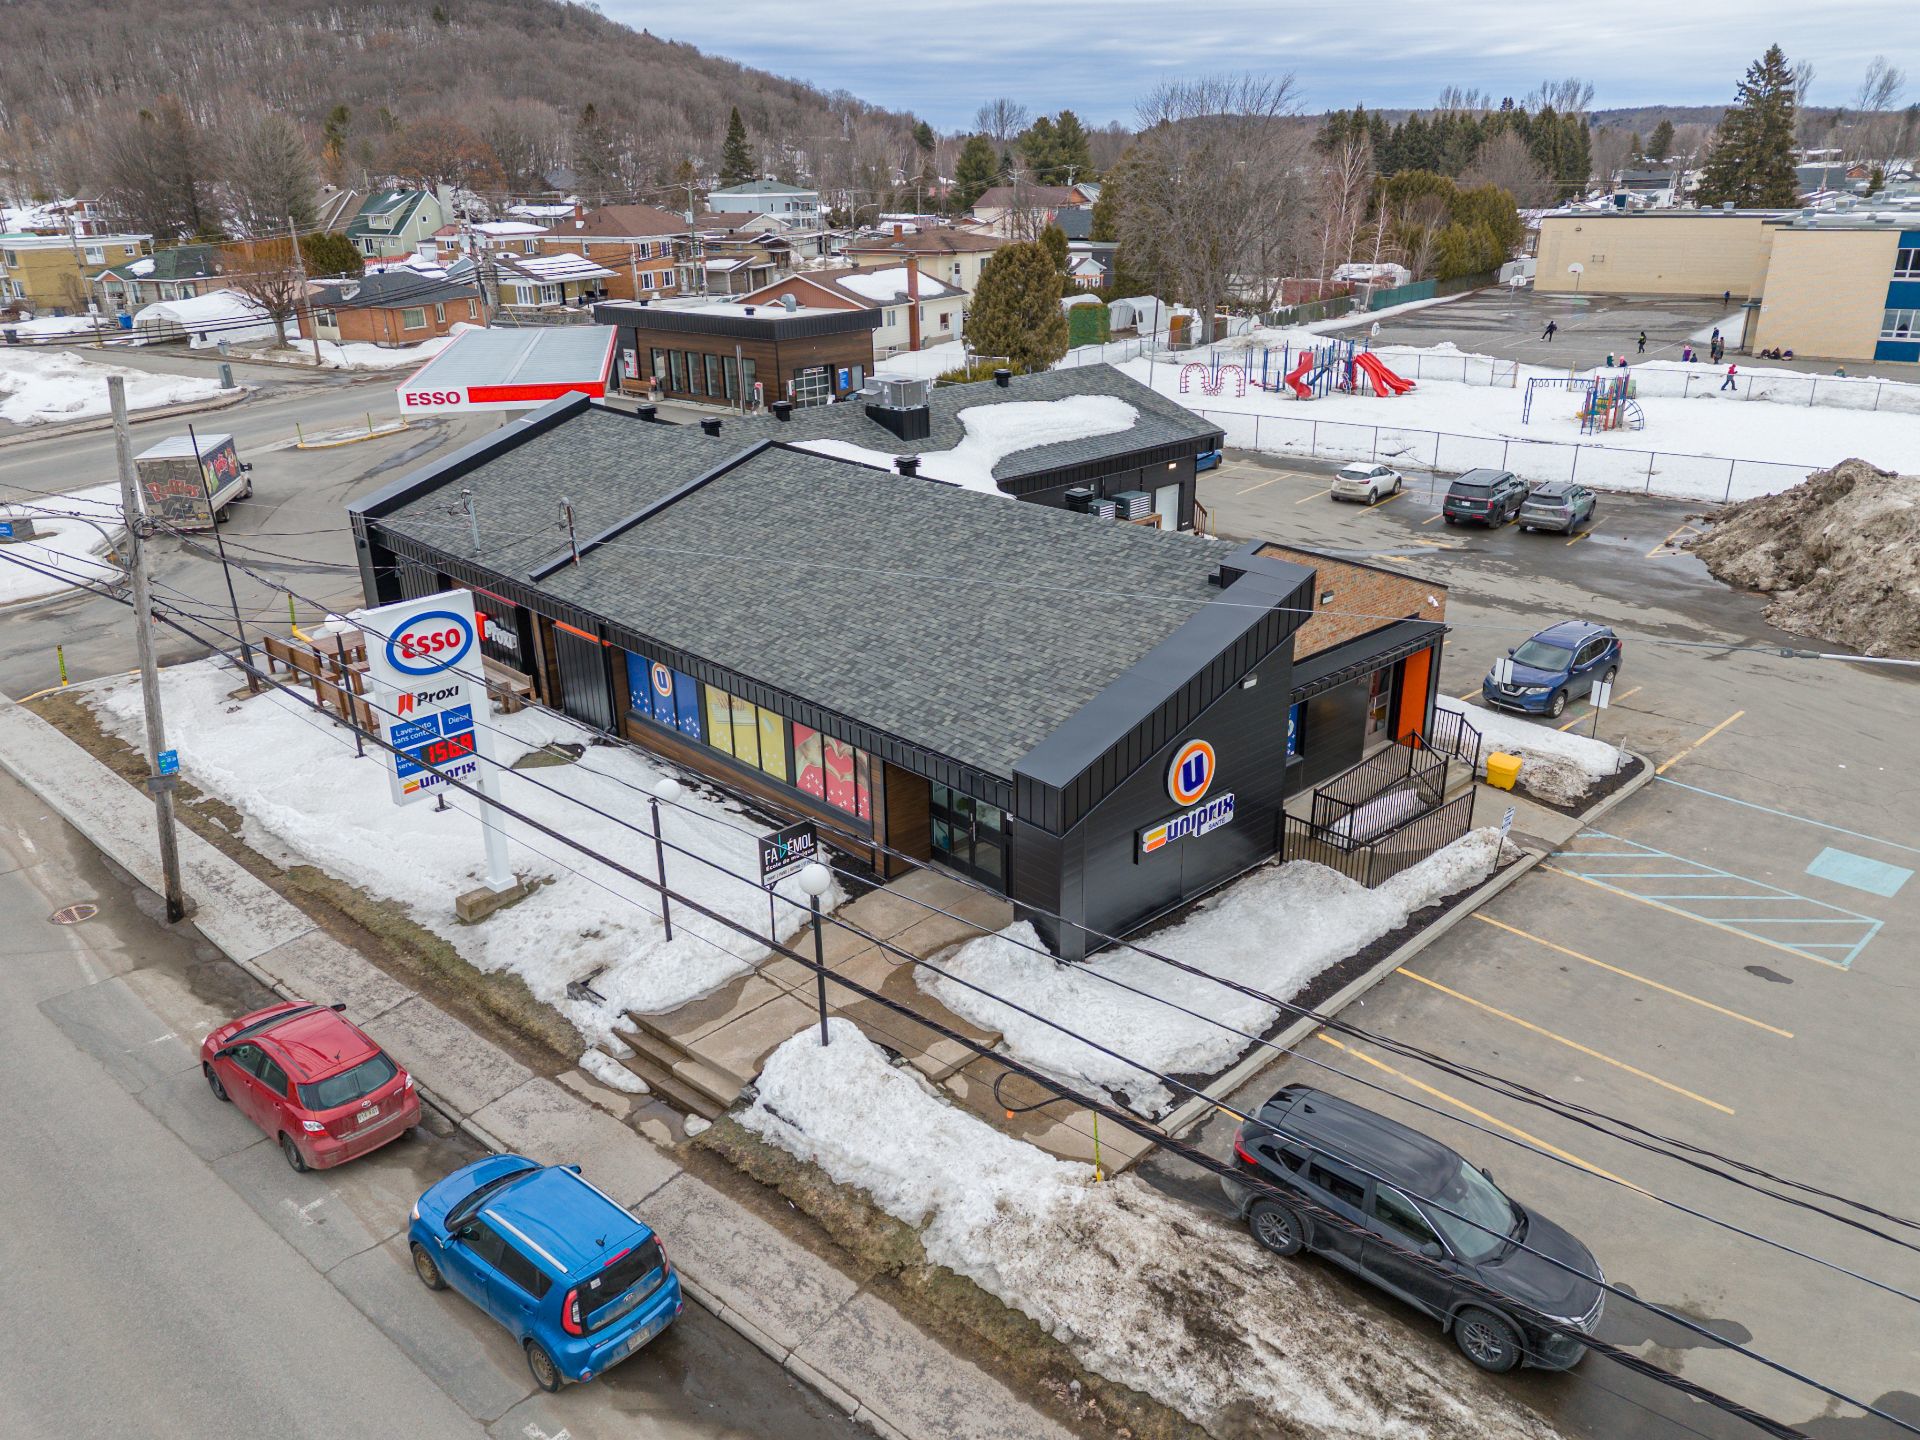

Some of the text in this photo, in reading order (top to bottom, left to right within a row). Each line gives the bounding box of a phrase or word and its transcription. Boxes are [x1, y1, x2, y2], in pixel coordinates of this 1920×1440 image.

[405, 391, 461, 405] ESSO
[416, 685, 459, 707] Proxi
[393, 735, 410, 745] sans
[1167, 794, 1235, 837] uniprix
